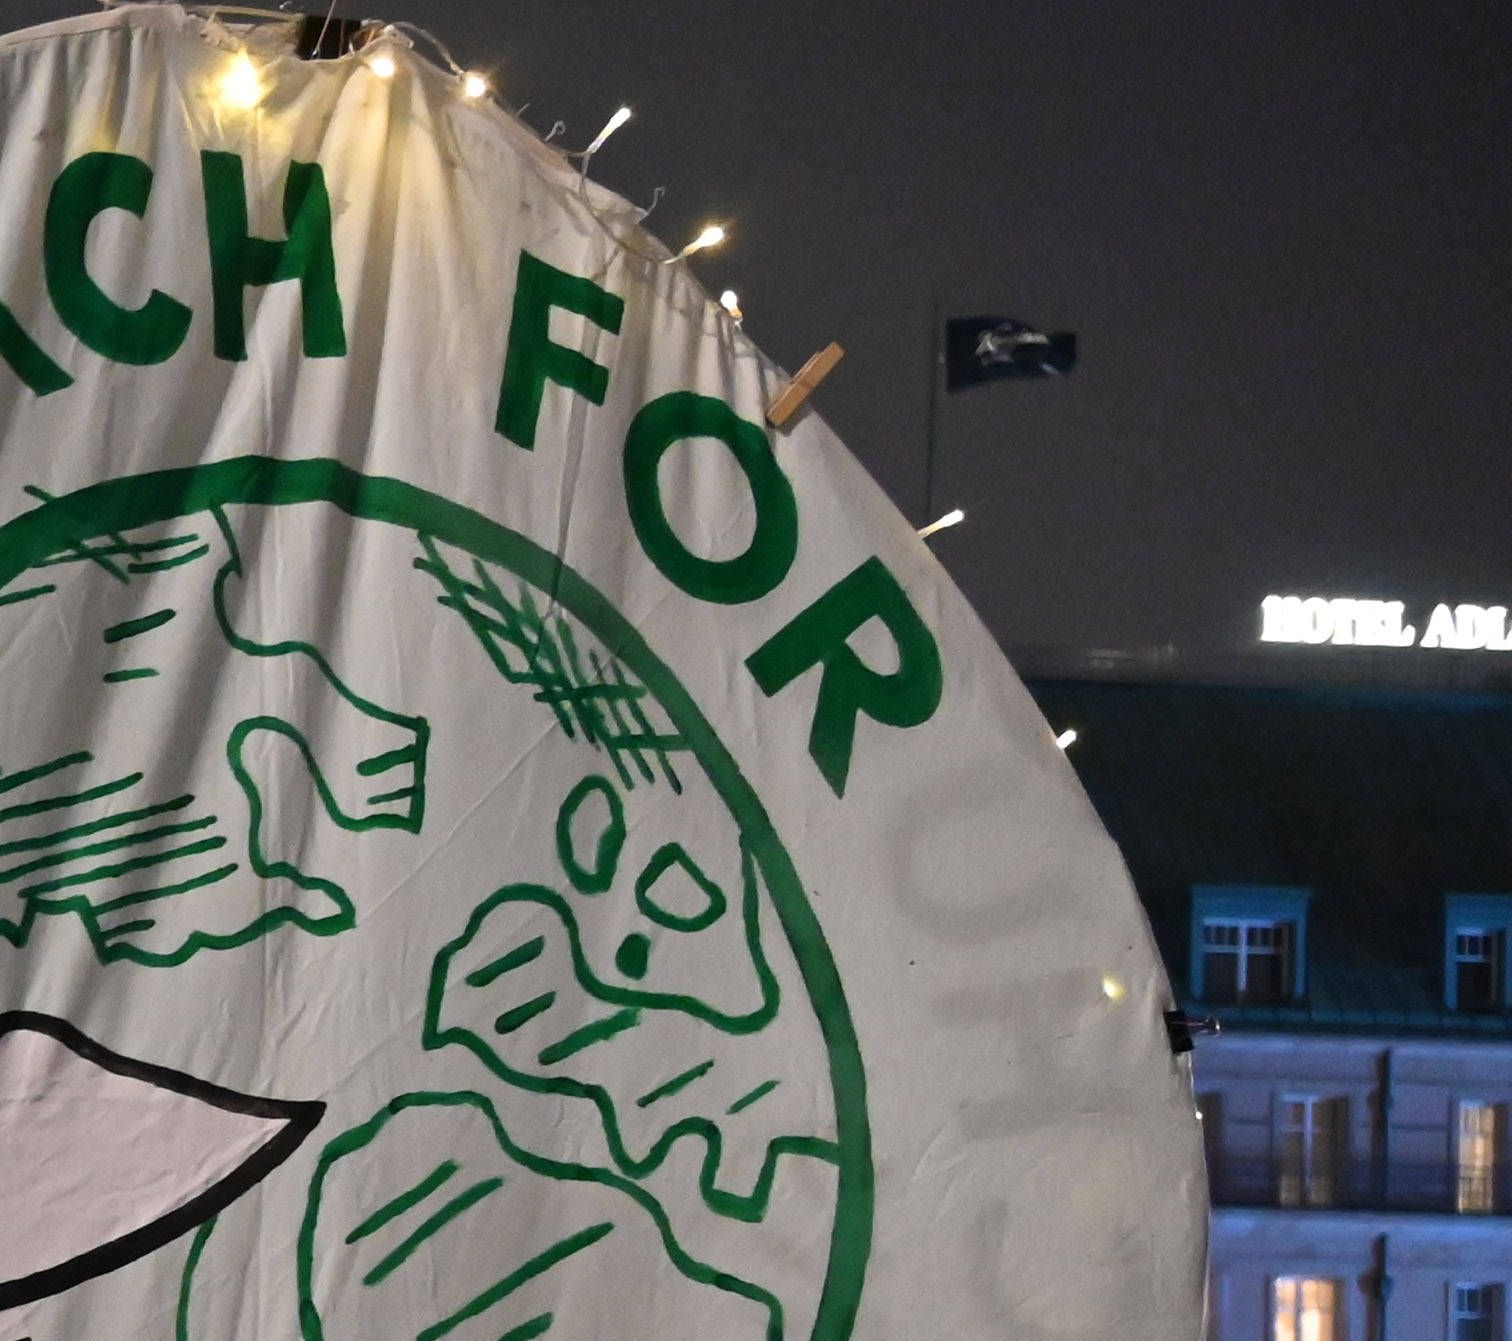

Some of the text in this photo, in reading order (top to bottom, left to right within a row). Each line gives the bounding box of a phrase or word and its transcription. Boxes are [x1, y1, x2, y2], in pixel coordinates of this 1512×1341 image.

[498, 254, 942, 797] FOR
[1260, 595, 1512, 650] HOTEL ADL
